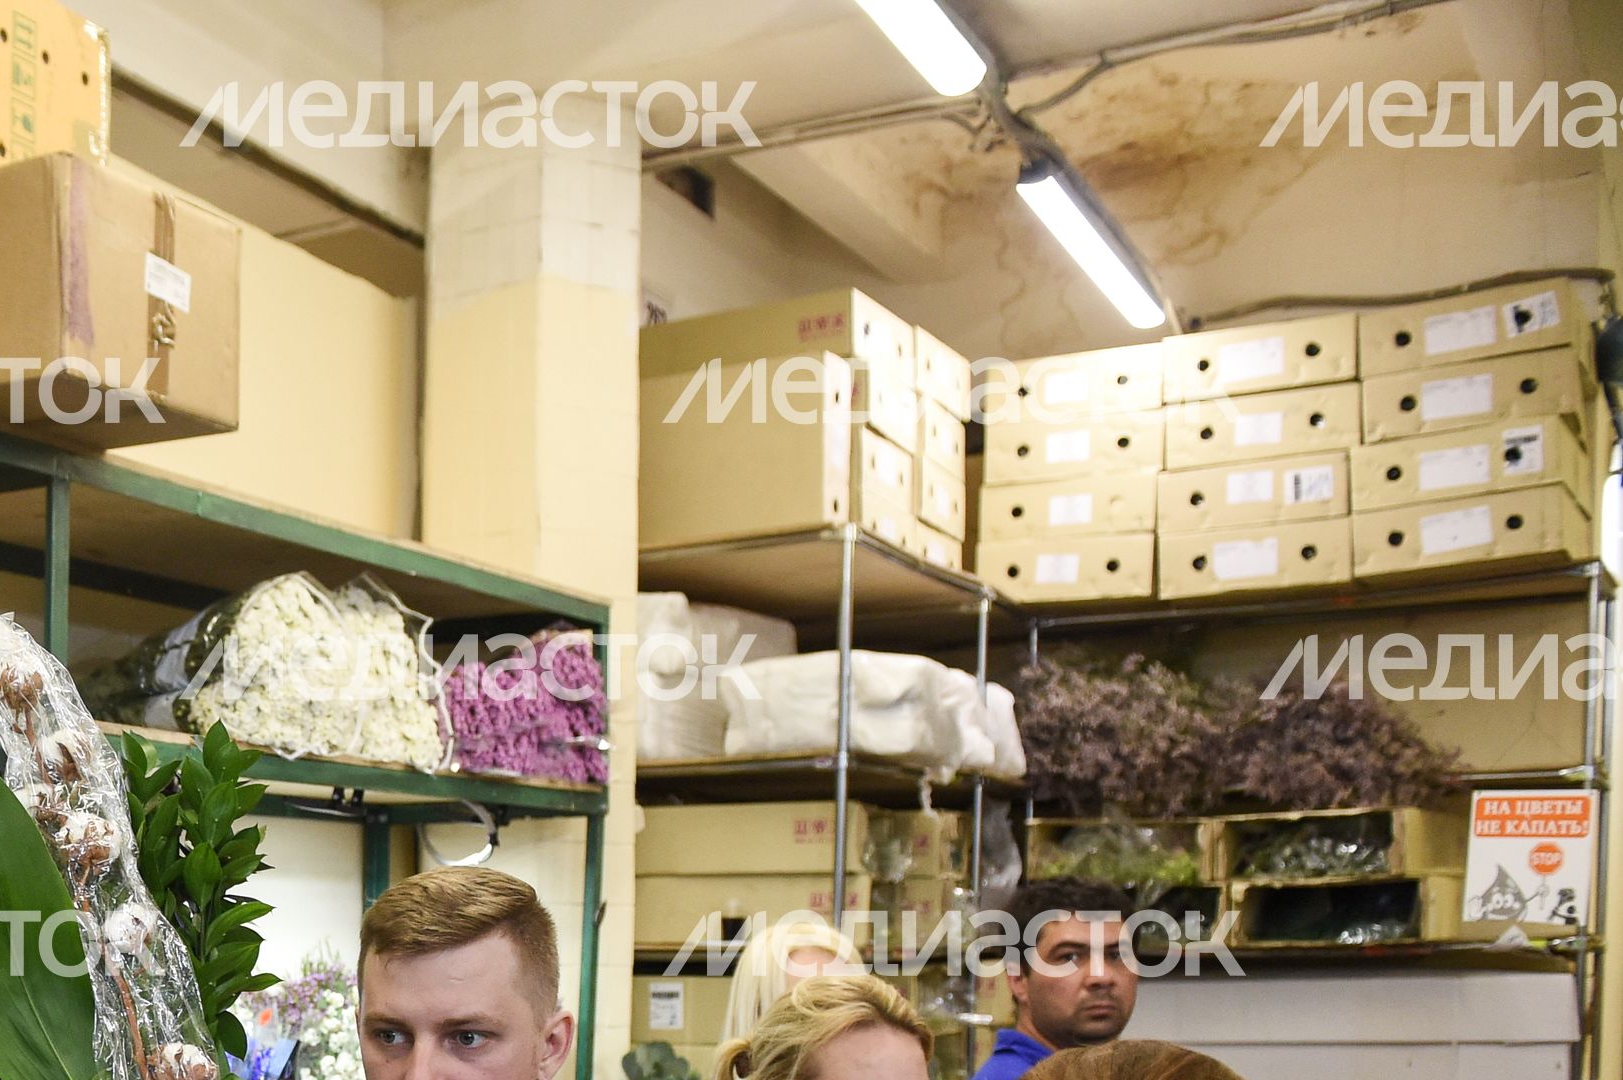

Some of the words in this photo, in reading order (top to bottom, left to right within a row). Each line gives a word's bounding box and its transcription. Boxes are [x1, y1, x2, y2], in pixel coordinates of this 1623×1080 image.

[1483, 801, 1511, 815] НА
[1515, 799, 1584, 817] ЦВЕТЫ
[1476, 820, 1501, 835] НЕ
[1505, 819, 1589, 835] КАПАТЬ!
[1530, 852, 1563, 866] STOP
